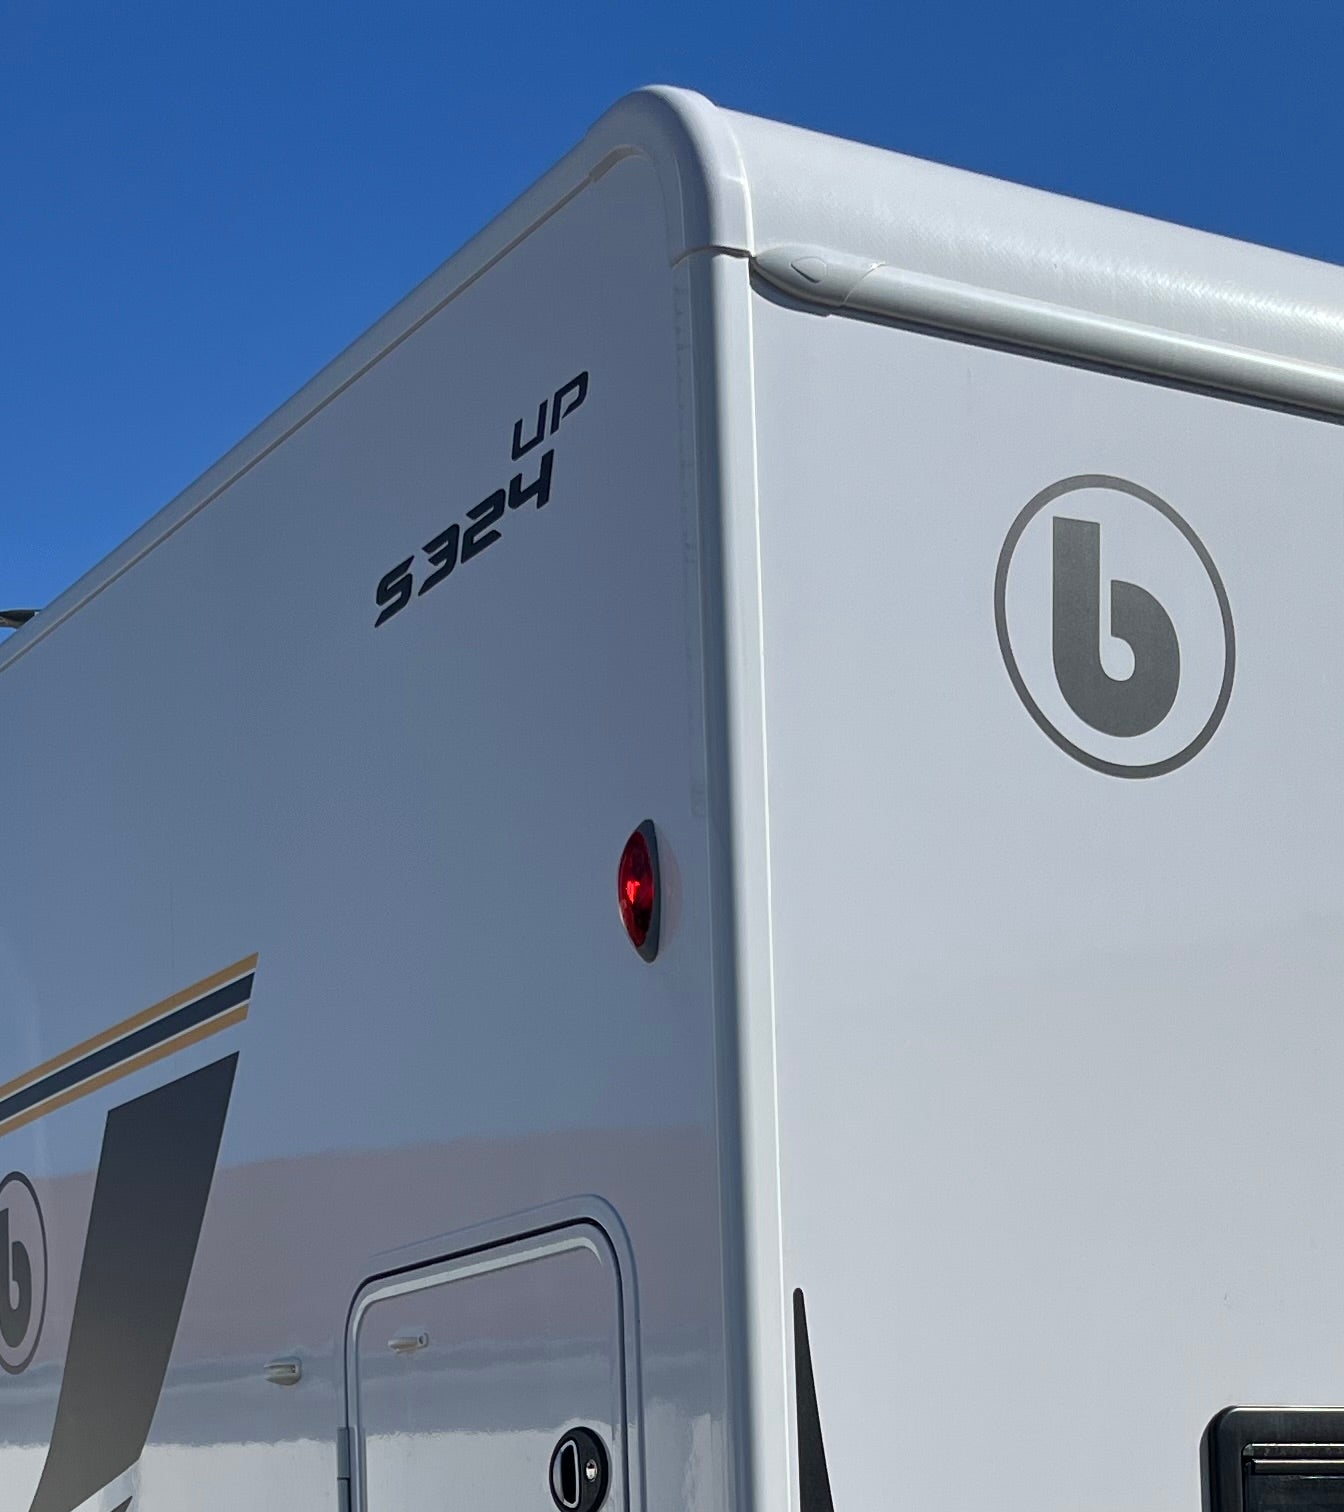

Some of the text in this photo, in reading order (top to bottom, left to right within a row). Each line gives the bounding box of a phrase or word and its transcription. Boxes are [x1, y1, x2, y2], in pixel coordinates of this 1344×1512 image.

[511, 370, 589, 462] UP
[373, 448, 555, 629] S324
[1052, 515, 1181, 738] b
